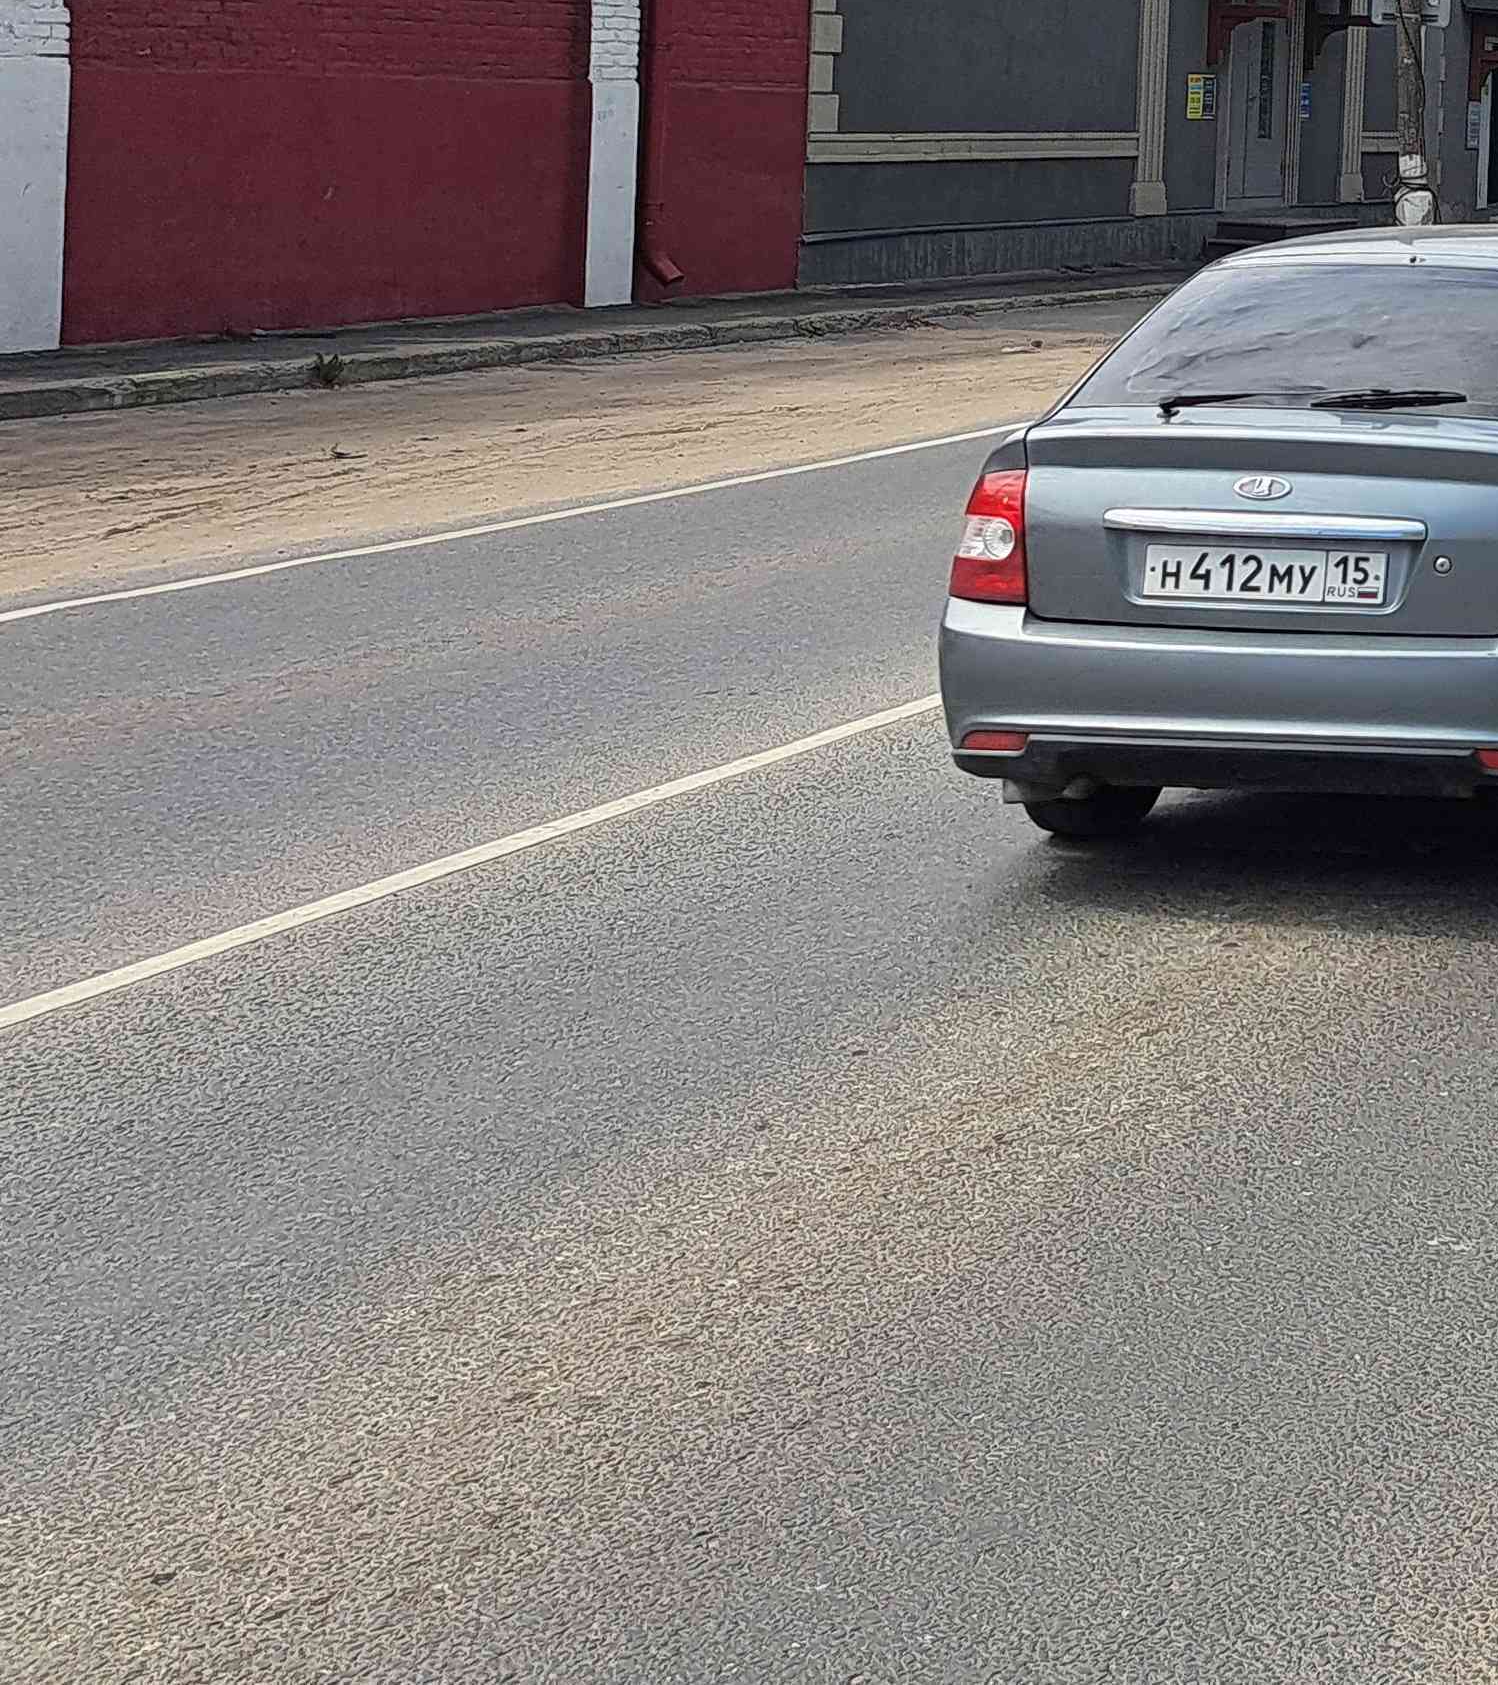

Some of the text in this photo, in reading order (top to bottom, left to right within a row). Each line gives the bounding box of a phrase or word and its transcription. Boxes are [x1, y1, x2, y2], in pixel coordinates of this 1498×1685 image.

[1160, 552, 1371, 594] Н412МУ 15
[1326, 586, 1357, 598] RUS
